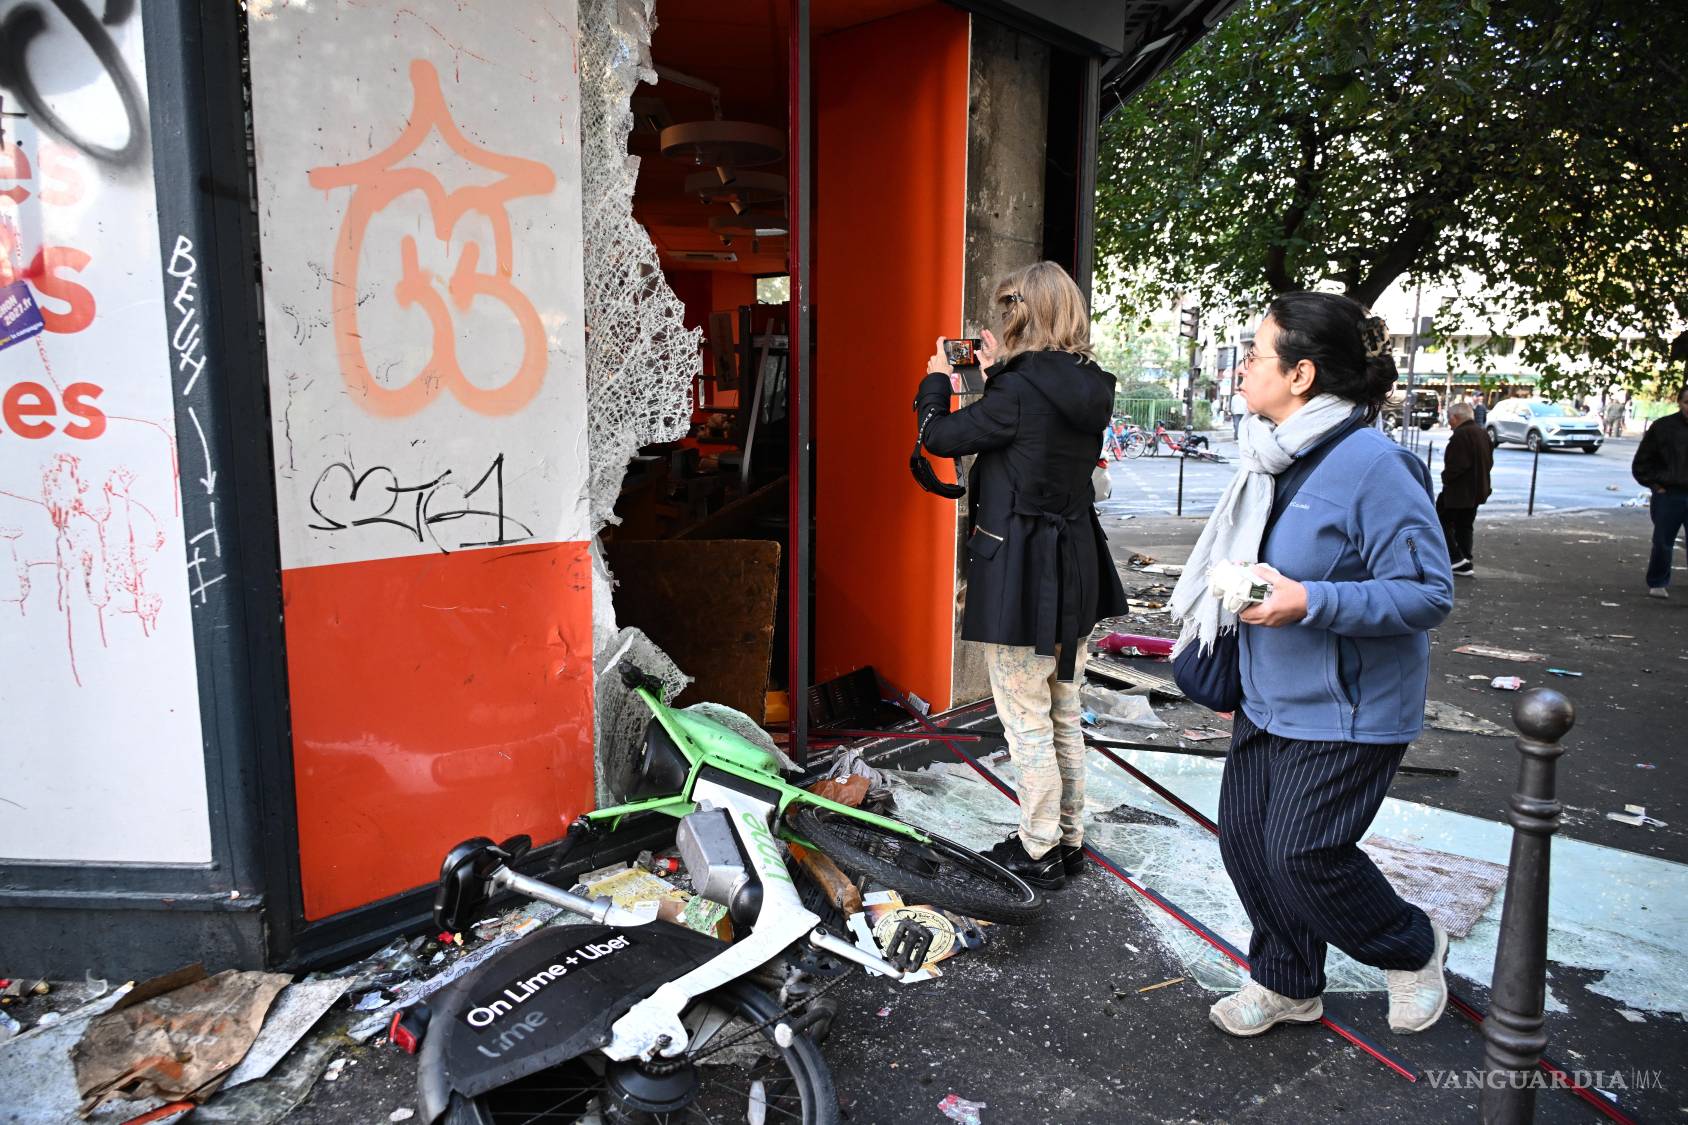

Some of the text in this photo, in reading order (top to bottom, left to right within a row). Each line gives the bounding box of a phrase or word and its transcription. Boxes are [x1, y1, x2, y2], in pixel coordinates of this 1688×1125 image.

[3, 297, 32, 327] 2027.fr
[167, 235, 208, 396] BEUH
[0, 381, 107, 440] es
[742, 812, 793, 884] Lime
[467, 1000, 513, 1027] On
[503, 963, 567, 1003] Lime
[575, 934, 631, 961] Uber
[477, 1010, 549, 1058] Lime
